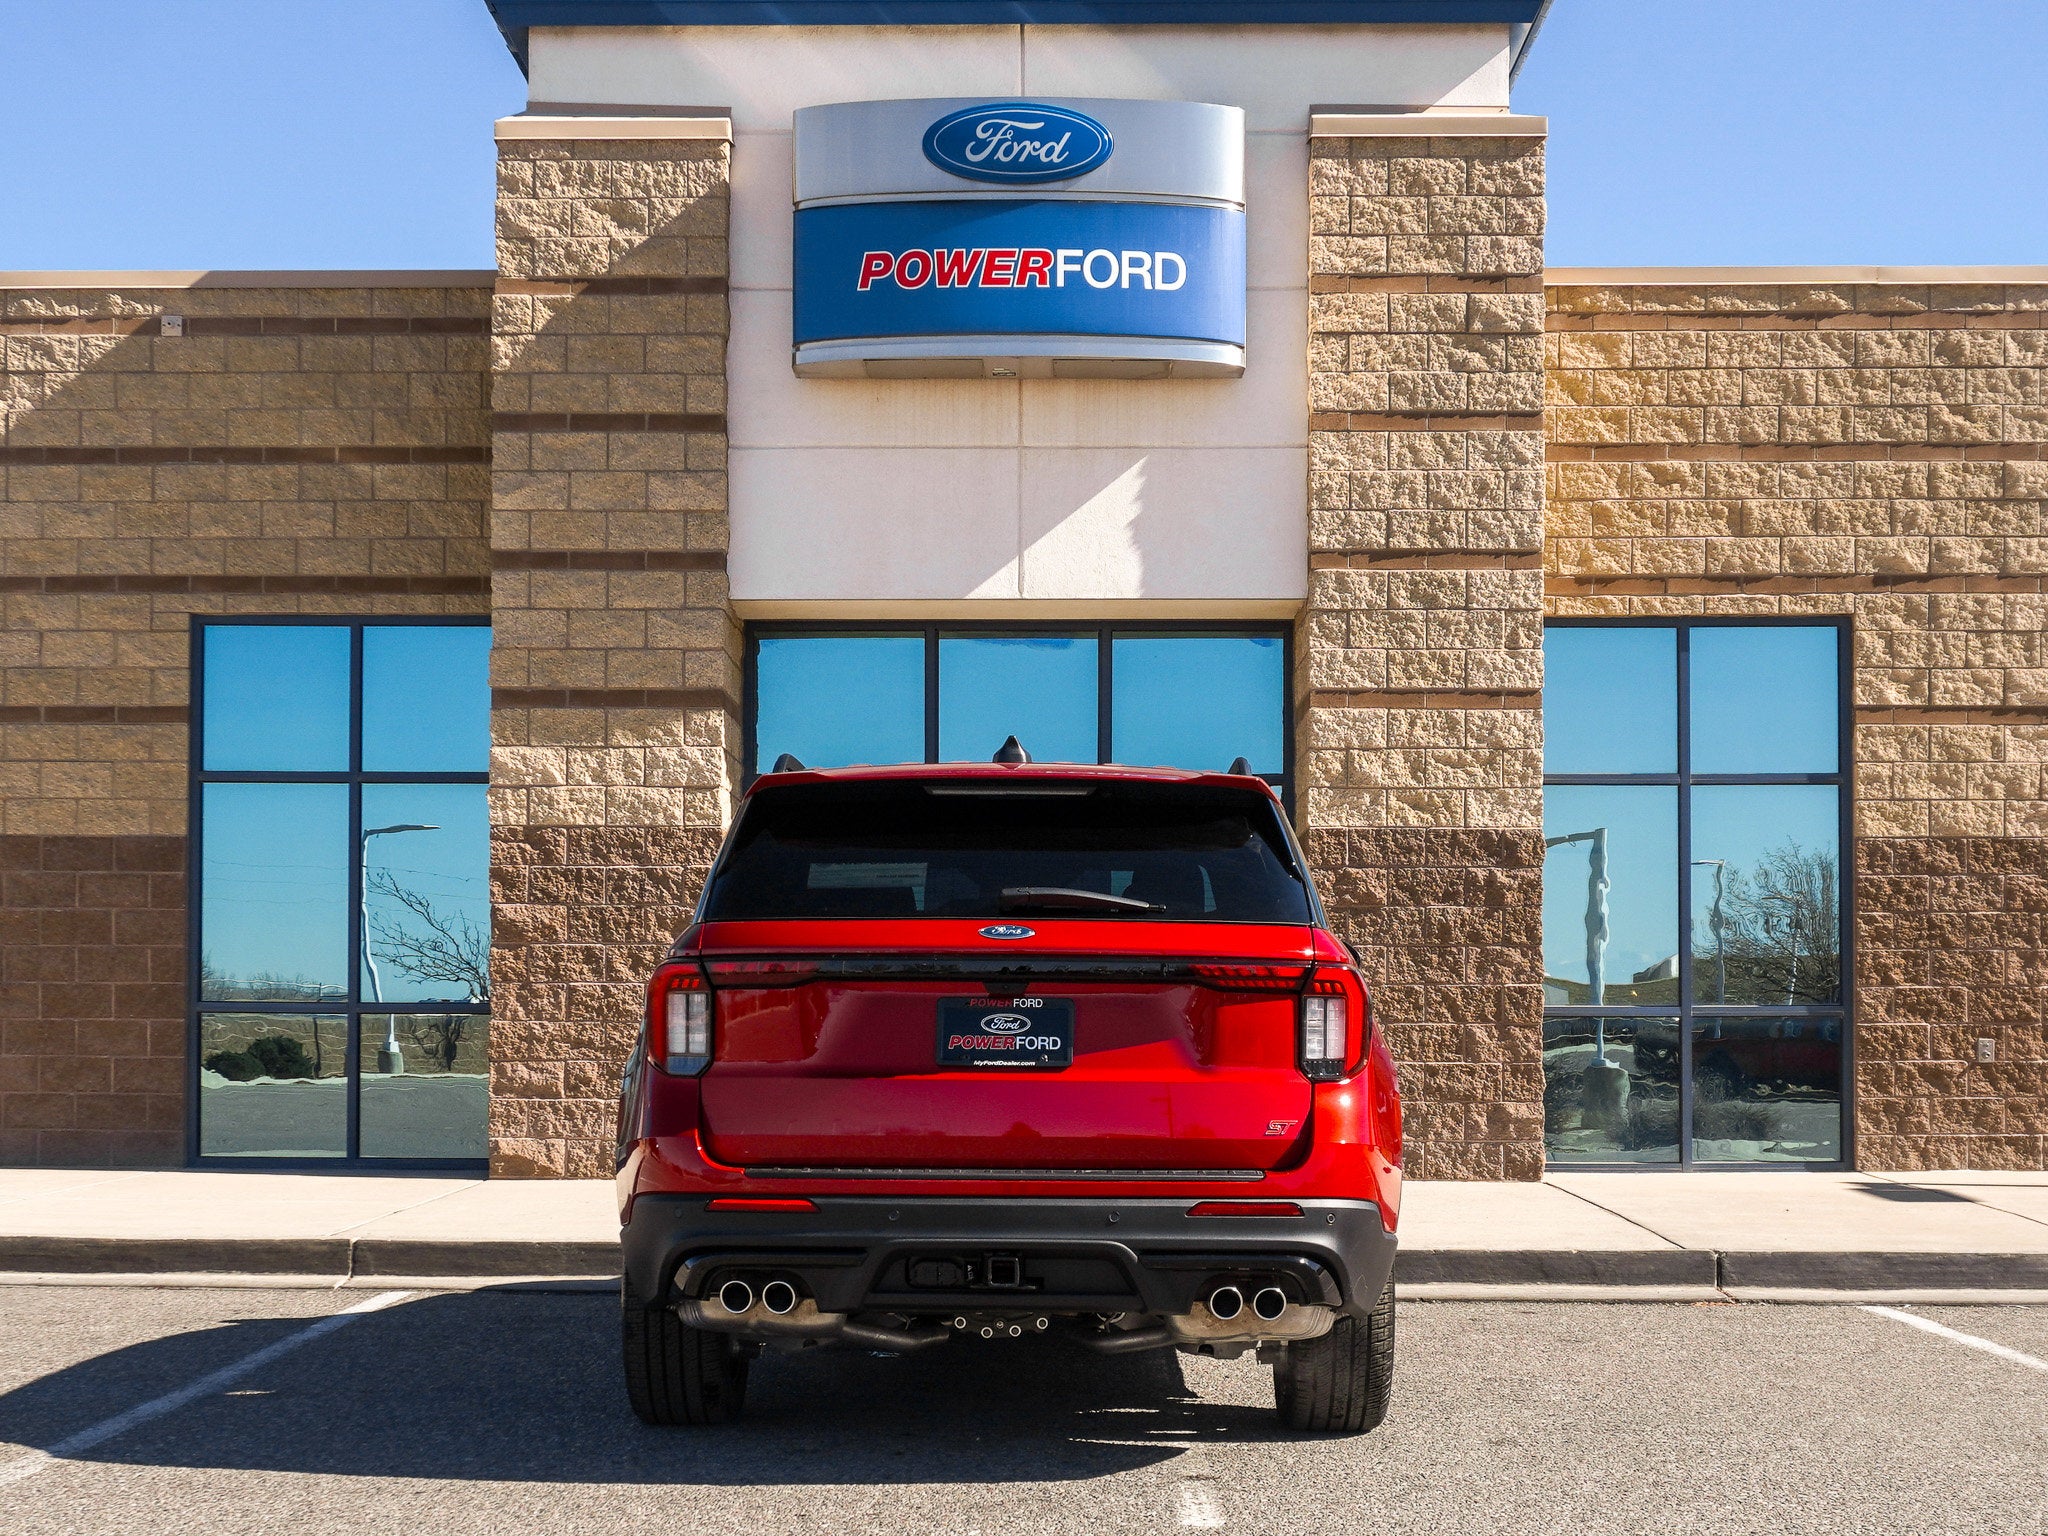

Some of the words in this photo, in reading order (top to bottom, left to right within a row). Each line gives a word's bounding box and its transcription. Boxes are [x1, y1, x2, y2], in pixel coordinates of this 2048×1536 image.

[966, 120, 1072, 164] Ford
[857, 248, 1188, 291] POWERFORD
[970, 998, 1043, 1008] POWERFORD
[990, 1016, 1021, 1030] Ford
[948, 1035, 1061, 1050] POWERFORD
[1265, 1120, 1299, 1135] ST
